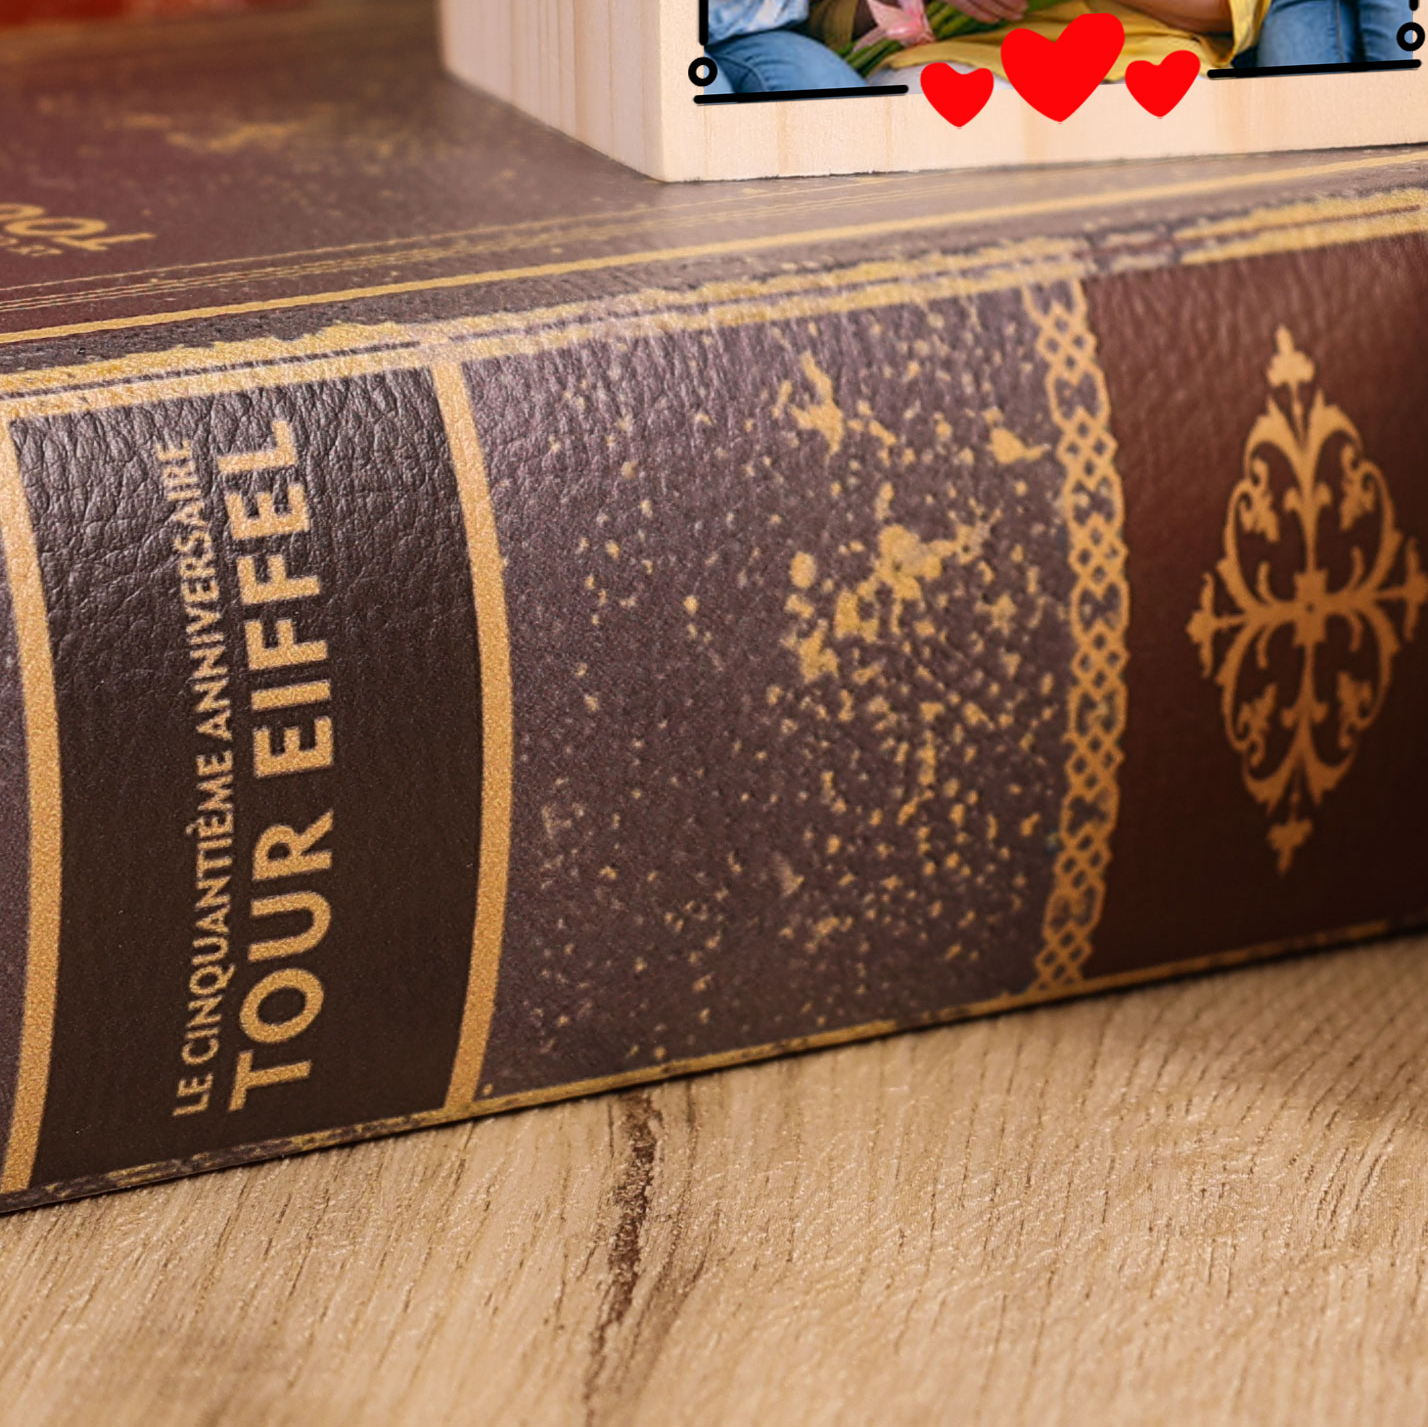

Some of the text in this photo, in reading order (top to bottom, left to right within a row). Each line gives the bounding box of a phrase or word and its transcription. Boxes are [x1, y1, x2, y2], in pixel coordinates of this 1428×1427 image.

[154, 439, 236, 1117] LE CINQUANTIÈME ANNIVERSAIRE
[216, 418, 335, 1112] TOUR EIFFEL
